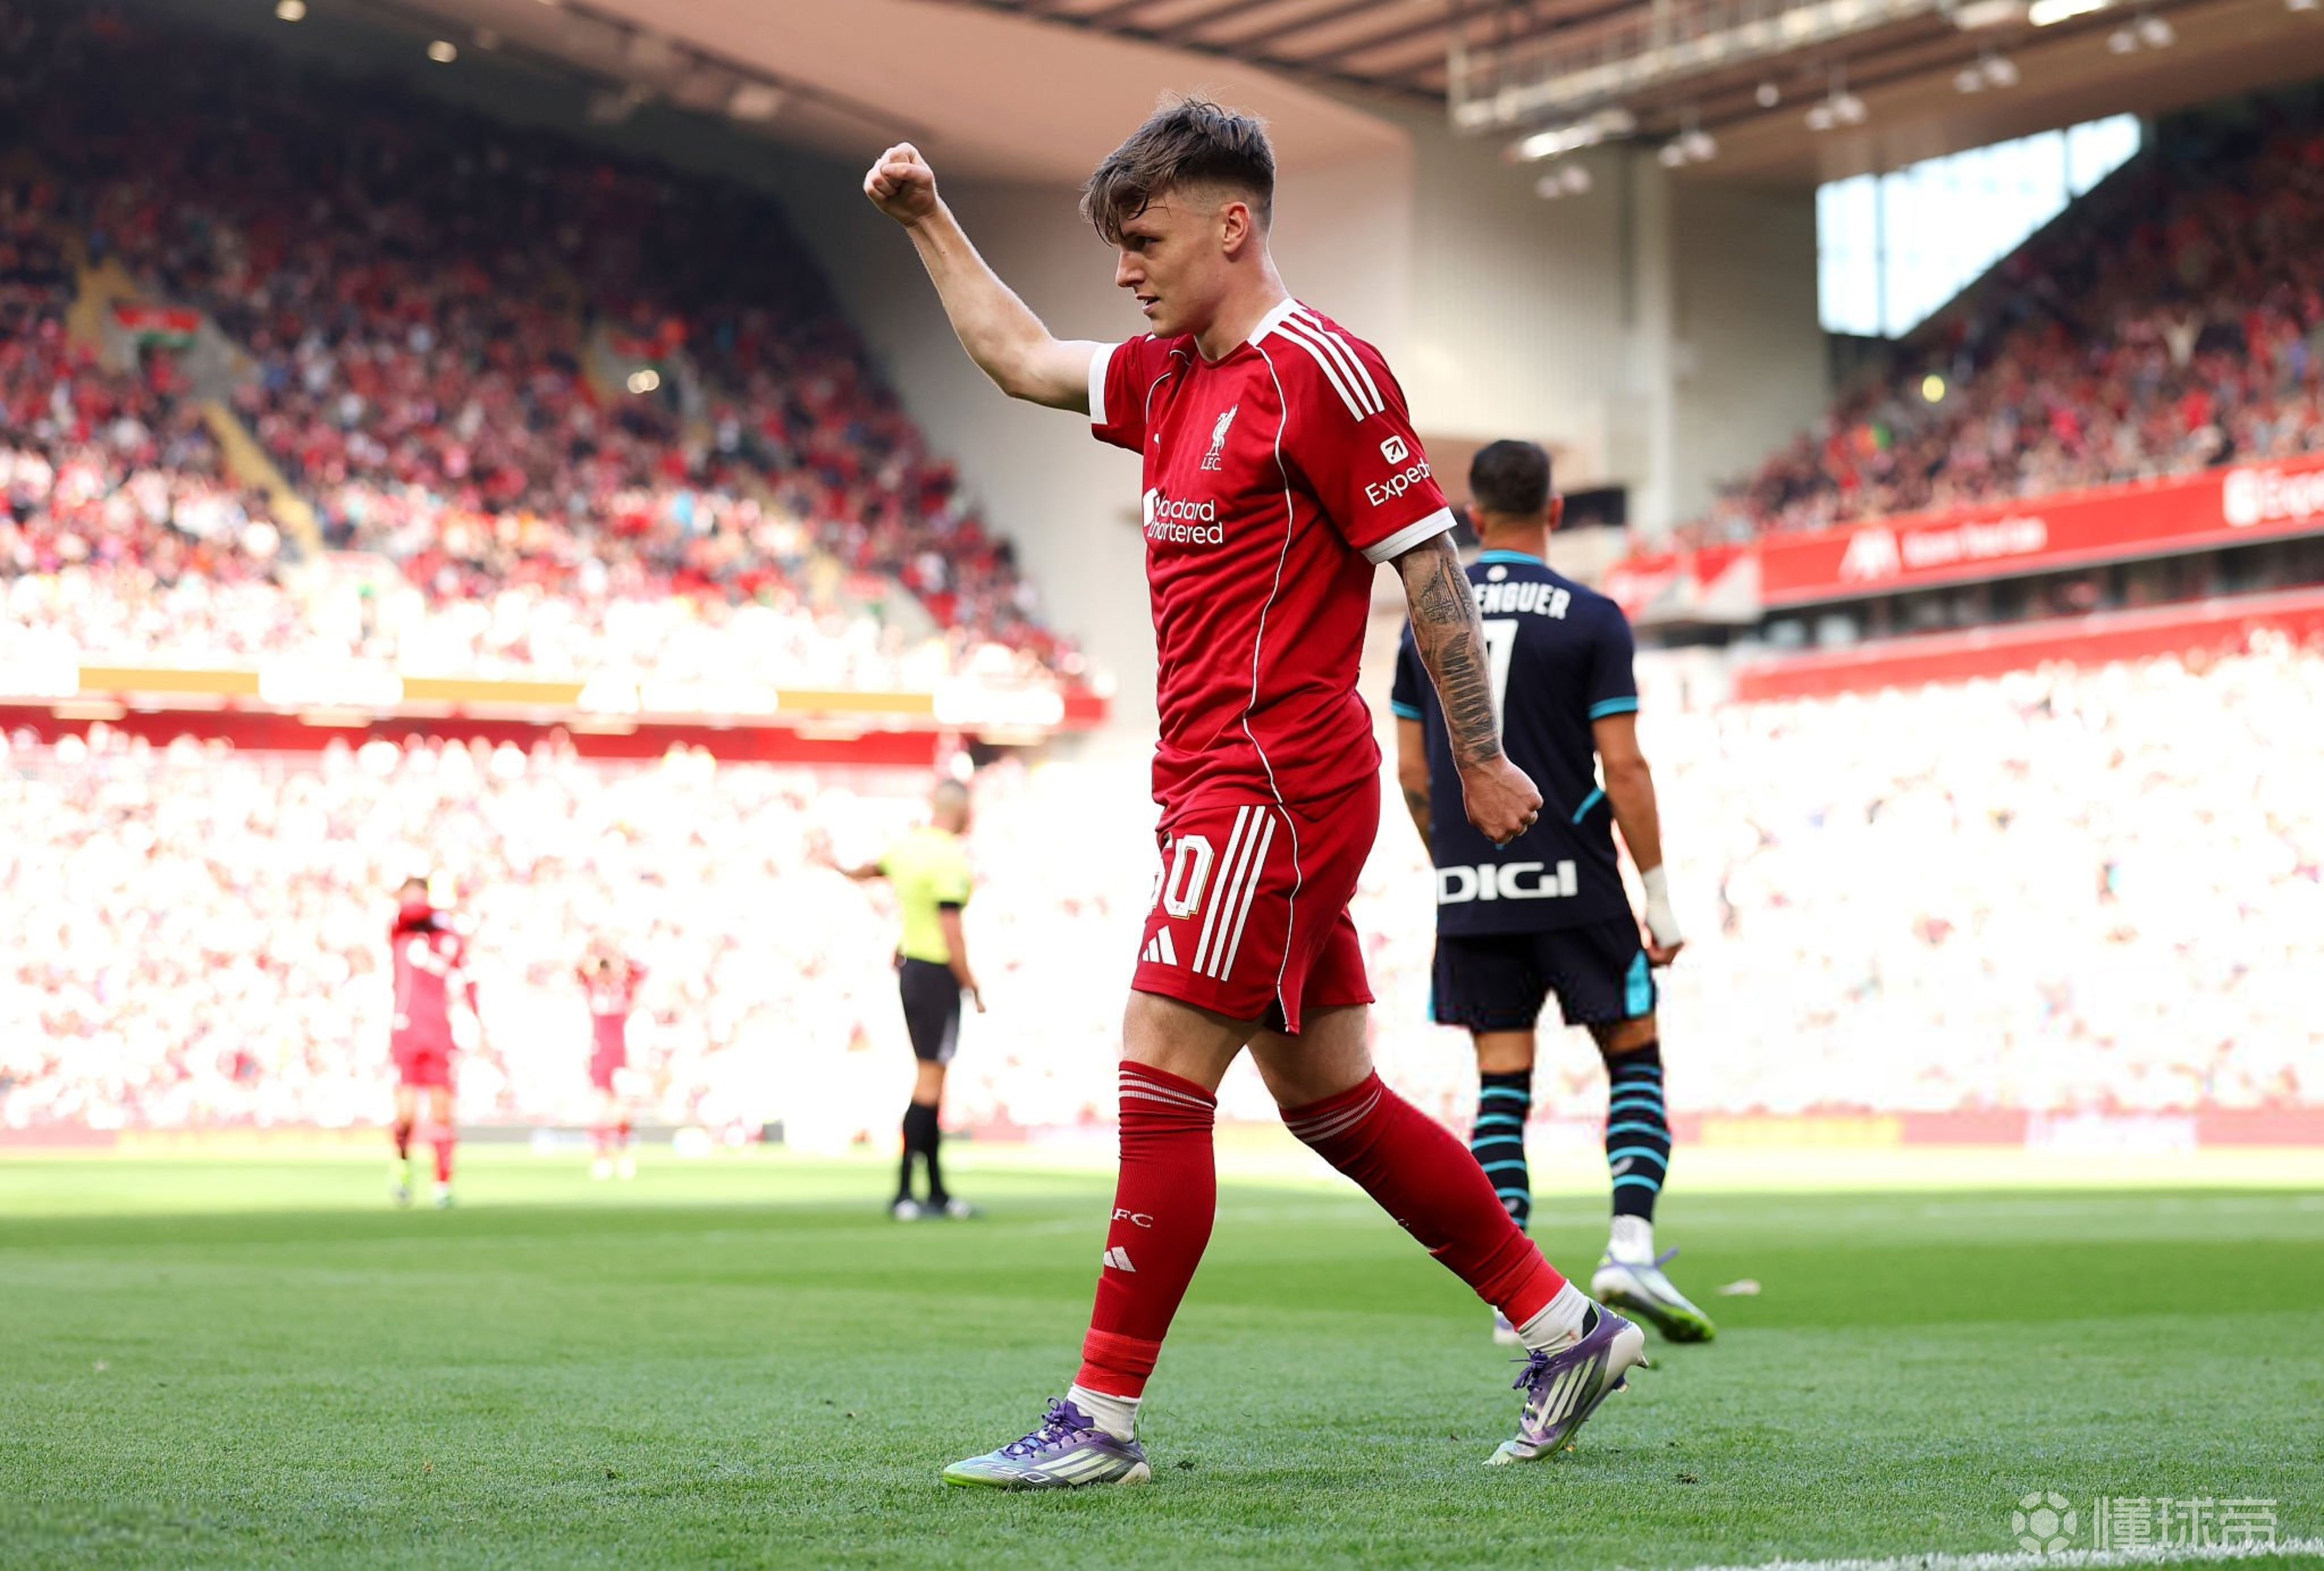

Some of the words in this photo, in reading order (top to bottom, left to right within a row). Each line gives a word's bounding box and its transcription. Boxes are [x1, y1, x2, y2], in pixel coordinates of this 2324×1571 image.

[1473, 581, 1571, 620] ENGUER
[1437, 859, 1578, 905] DIGI
[1112, 1208, 1153, 1228] FC
